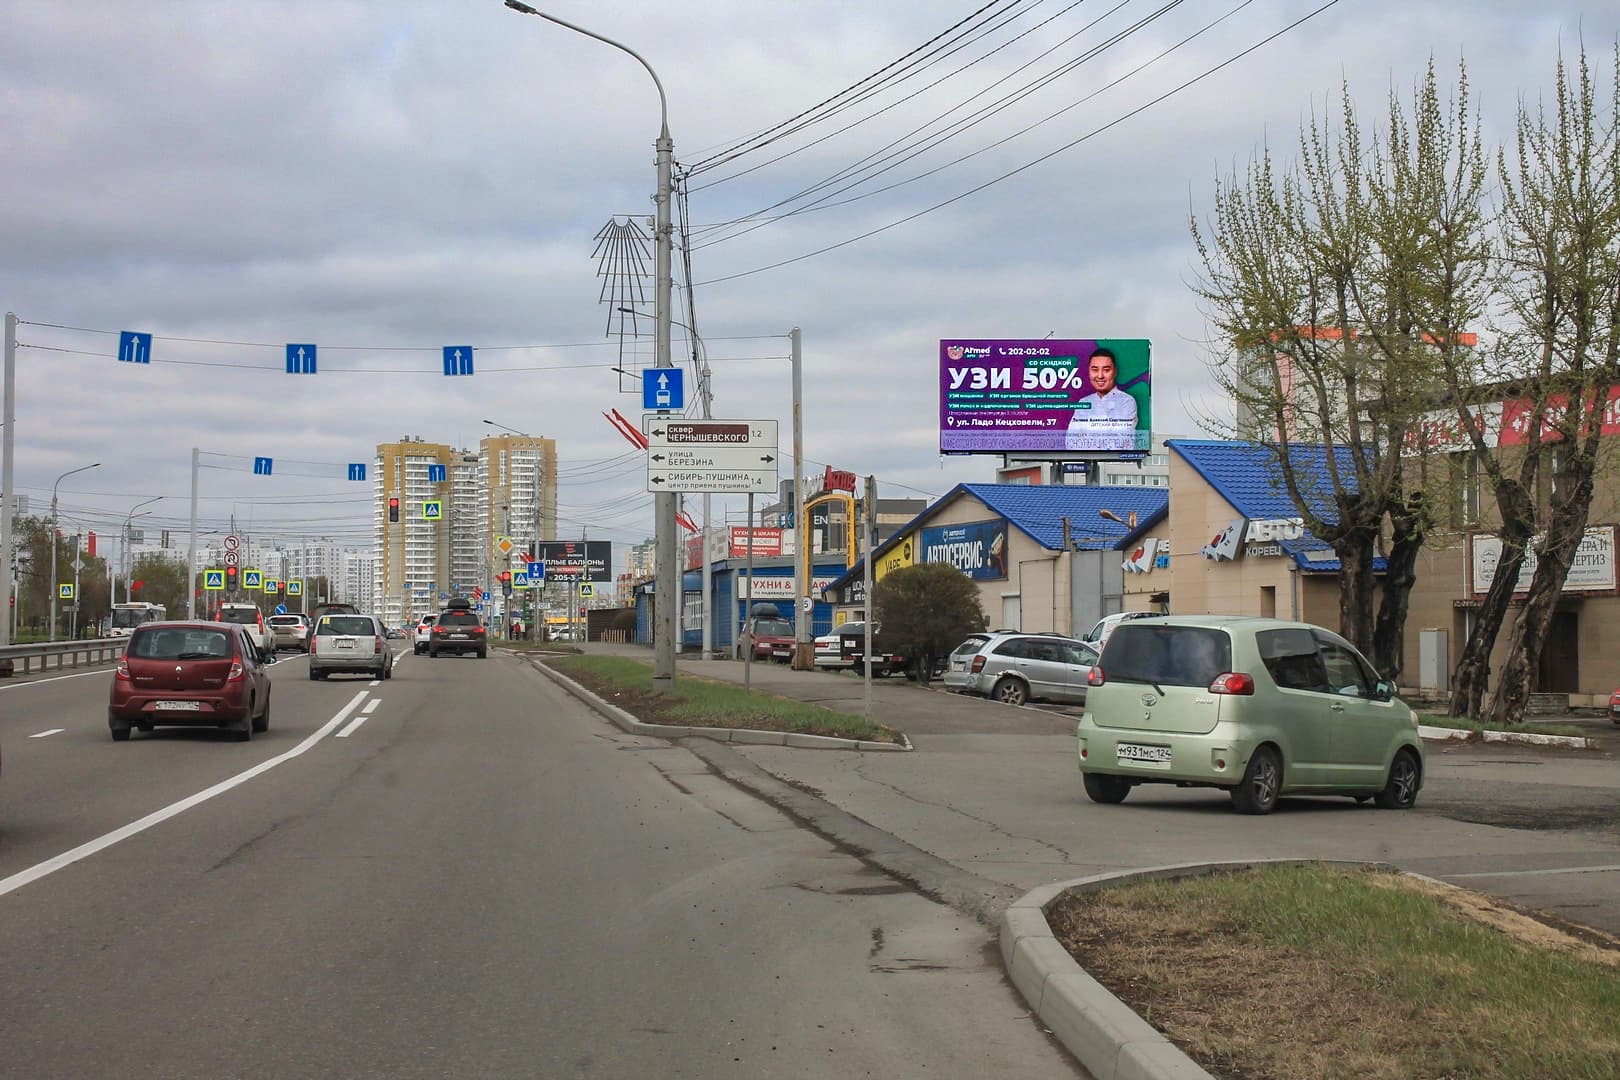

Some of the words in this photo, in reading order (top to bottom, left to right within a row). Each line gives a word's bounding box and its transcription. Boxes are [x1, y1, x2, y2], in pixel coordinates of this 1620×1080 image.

[948, 367, 1011, 389] УЗИ
[1022, 367, 1083, 389] 50%
[956, 419, 969, 427] ул.
[971, 418, 993, 426] Ладо
[668, 433, 748, 442] ЧЕРНЫШЕВСКОГО
[668, 458, 714, 466] БЕРЕЗИНА
[668, 473, 749, 481] СИБИРЬ-ПУШНИНА
[927, 541, 983, 570] АВТОСЕРВИС
[1246, 546, 1281, 557] КОРЕЕЦ
[753, 581, 782, 589] УХНИ
[785, 581, 792, 589] &
